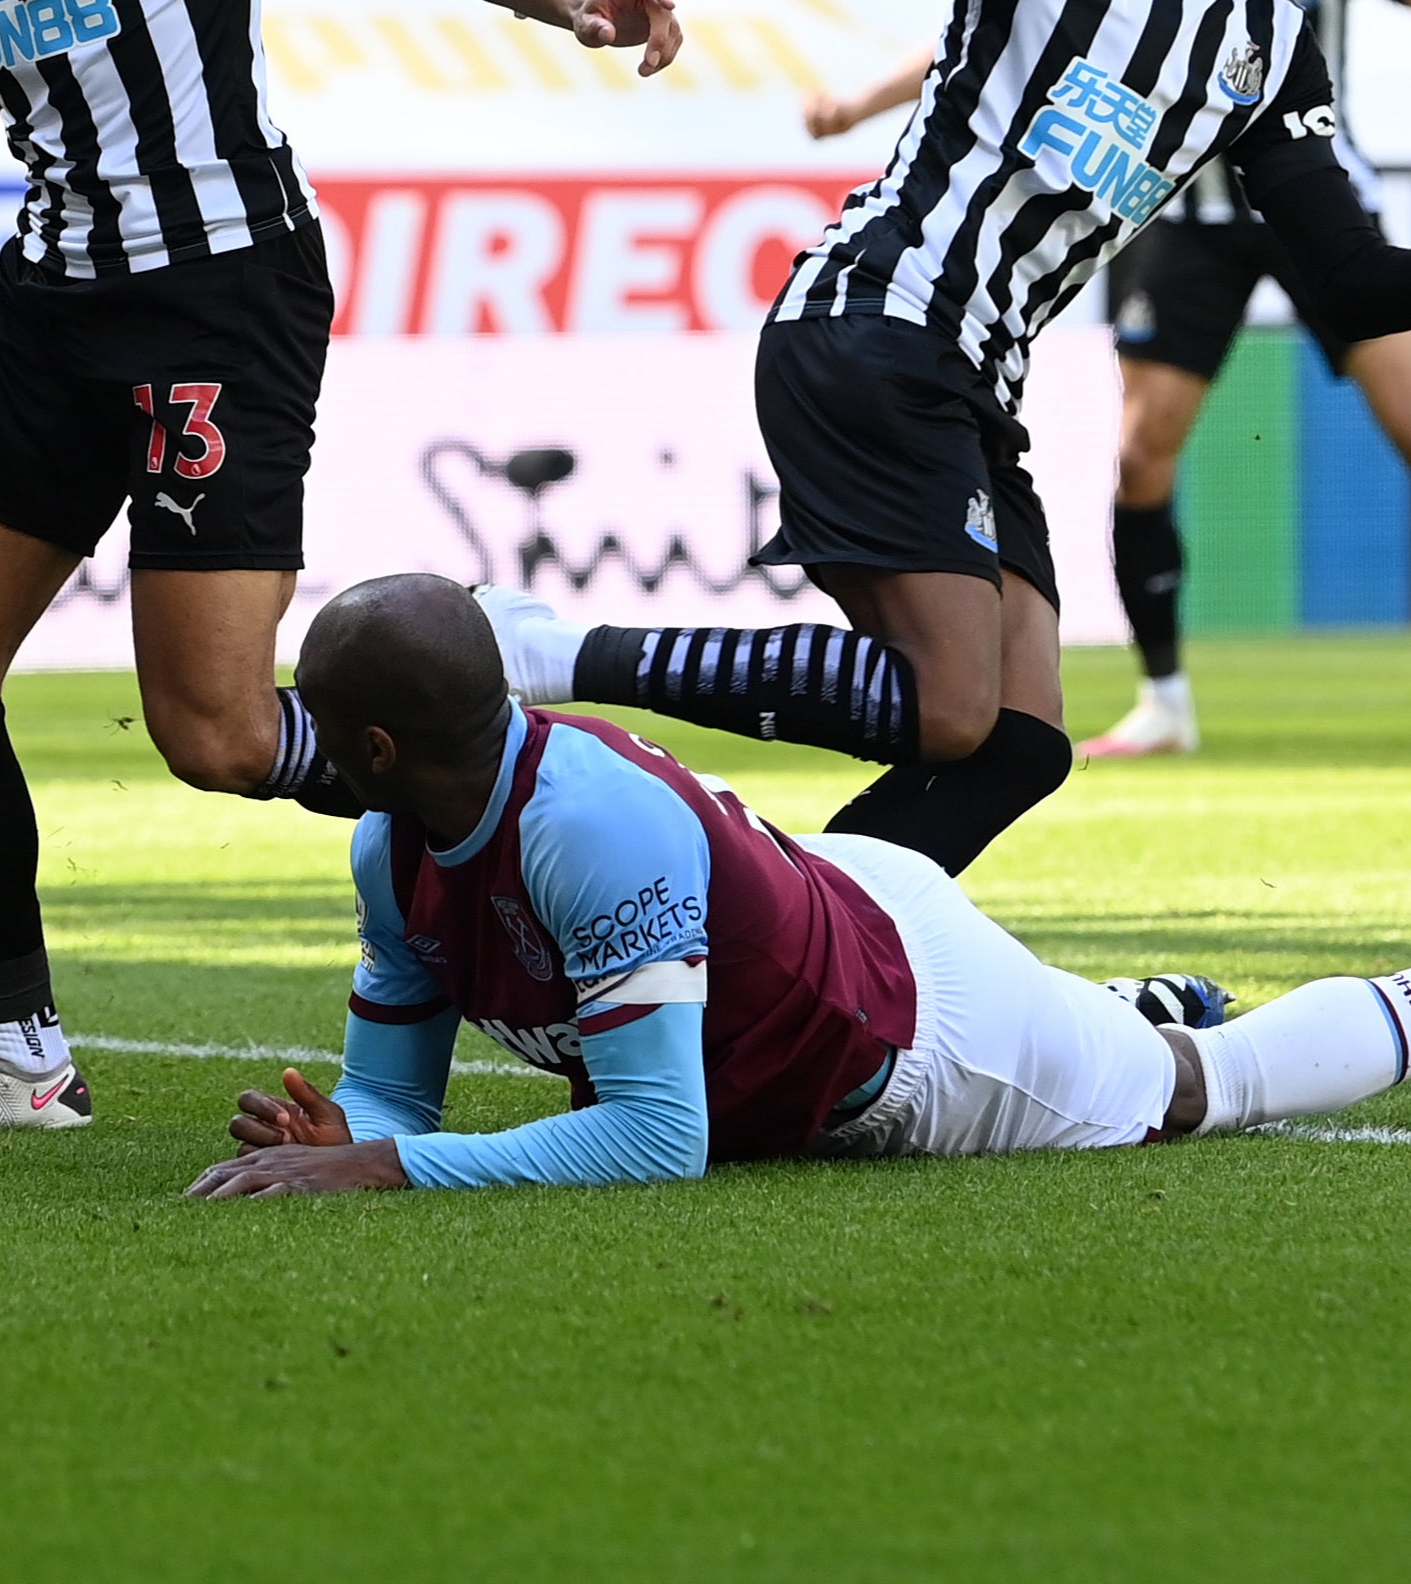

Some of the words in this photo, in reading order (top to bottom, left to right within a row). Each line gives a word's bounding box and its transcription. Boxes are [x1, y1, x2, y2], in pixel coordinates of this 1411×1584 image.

[1051, 59, 1158, 151] 乐天堂
[1022, 107, 1176, 224] FUN88
[131, 381, 227, 480] 13
[573, 876, 670, 948] SCOPE
[576, 896, 702, 974] MARKETS
[19, 1018, 46, 1058] ESIGN
